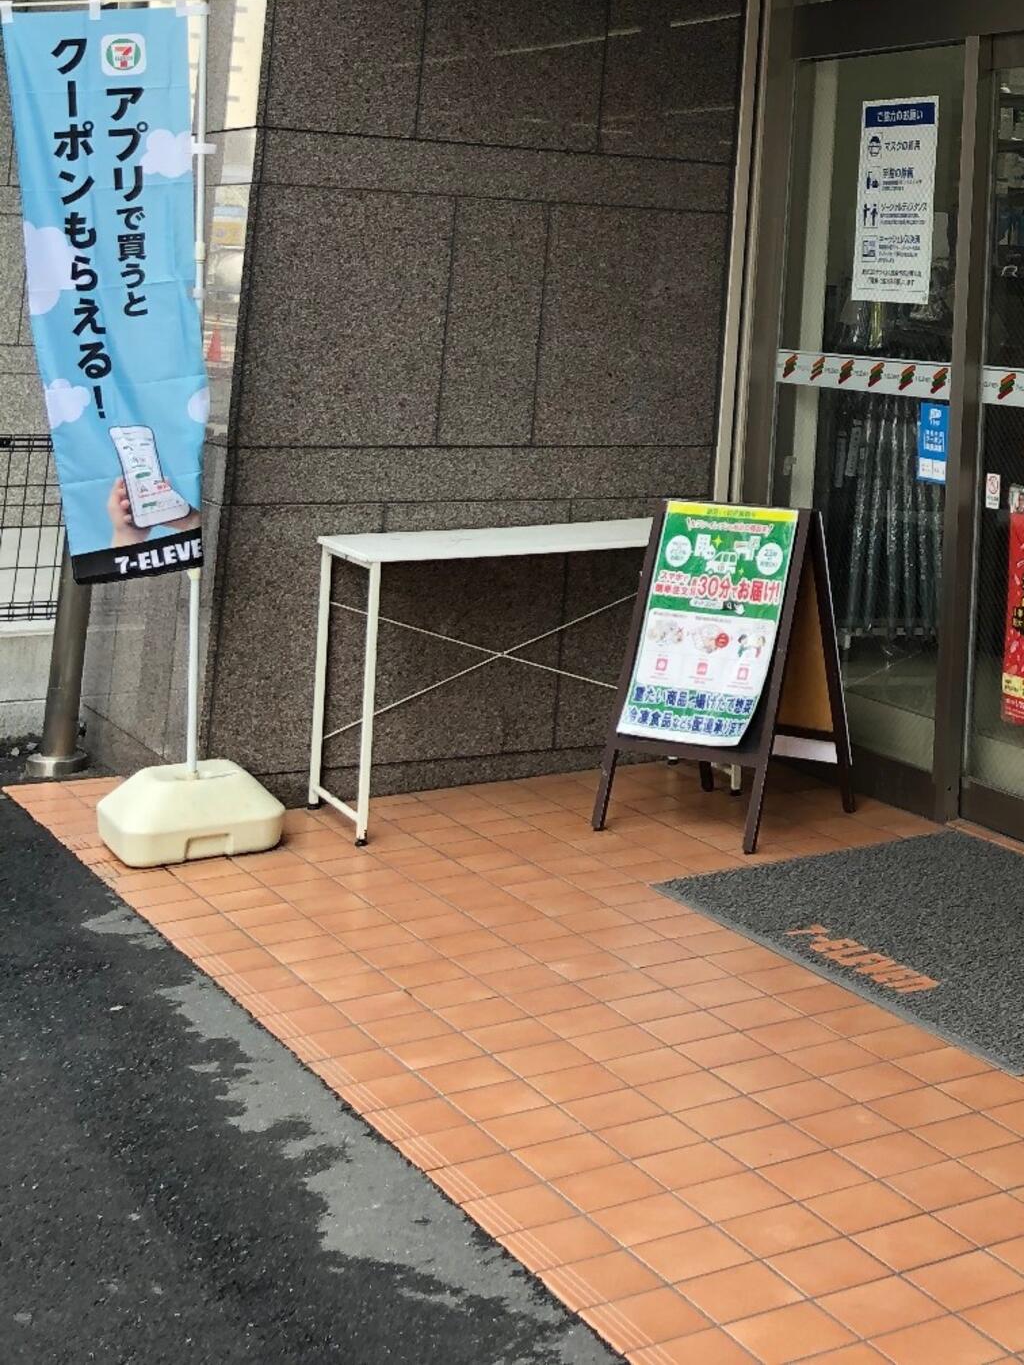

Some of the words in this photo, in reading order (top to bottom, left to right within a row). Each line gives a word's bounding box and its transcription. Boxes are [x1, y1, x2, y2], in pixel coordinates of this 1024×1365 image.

[105, 86, 148, 317] アプリで買うと
